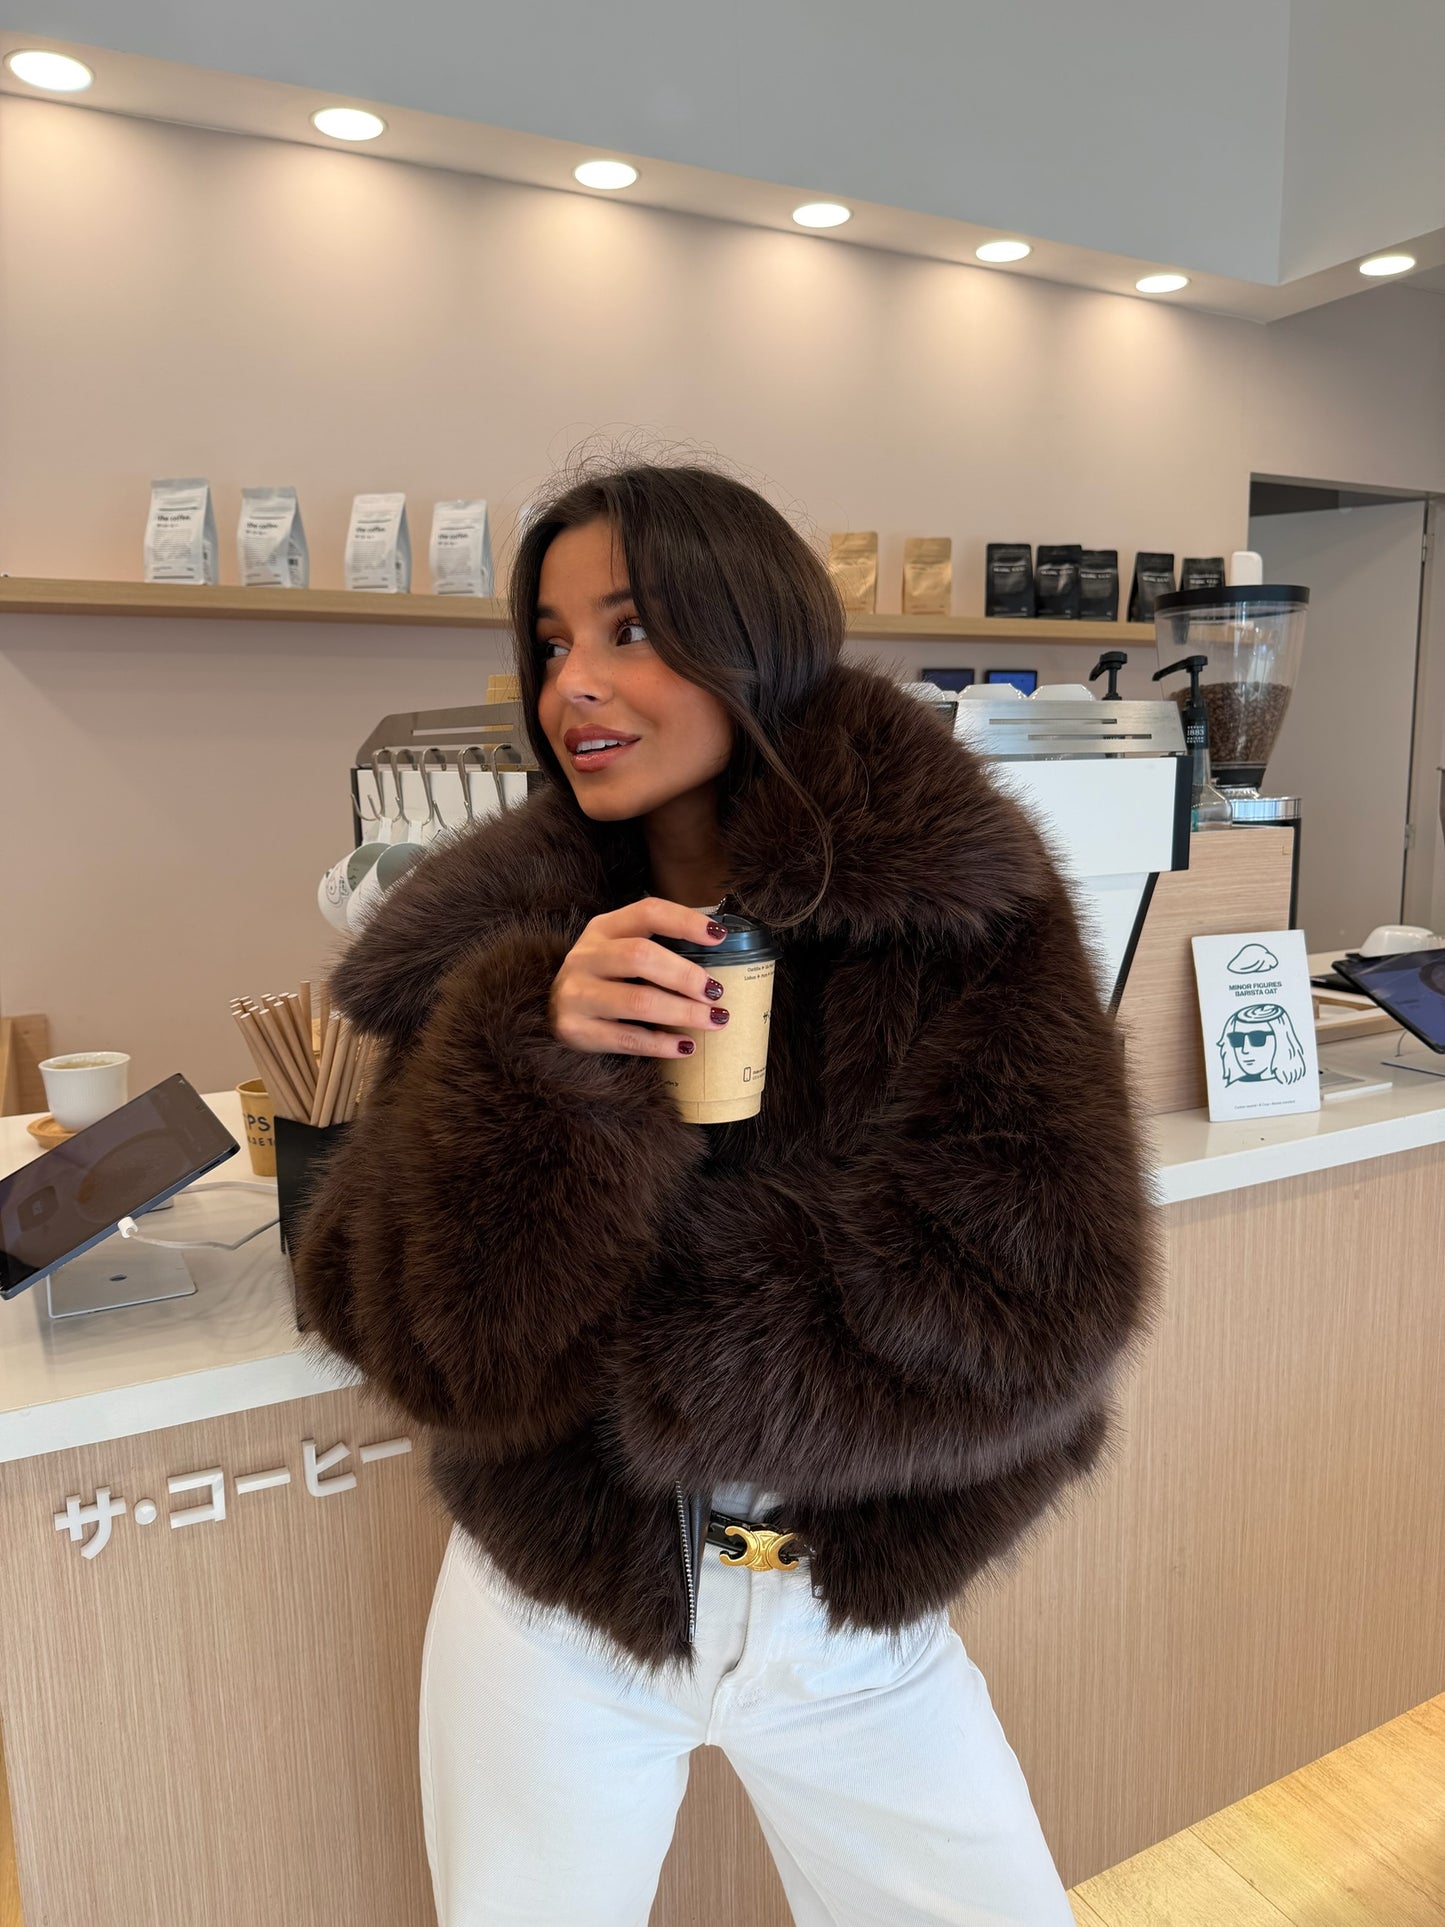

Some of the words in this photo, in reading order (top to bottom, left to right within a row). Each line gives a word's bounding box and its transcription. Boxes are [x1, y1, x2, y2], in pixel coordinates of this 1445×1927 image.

[1228, 983, 1252, 991] MINOR
[1252, 981, 1283, 989] FIGURES
[1235, 989, 1264, 997] BARISTA
[54, 1436, 413, 1561] ザ・コーヒー
